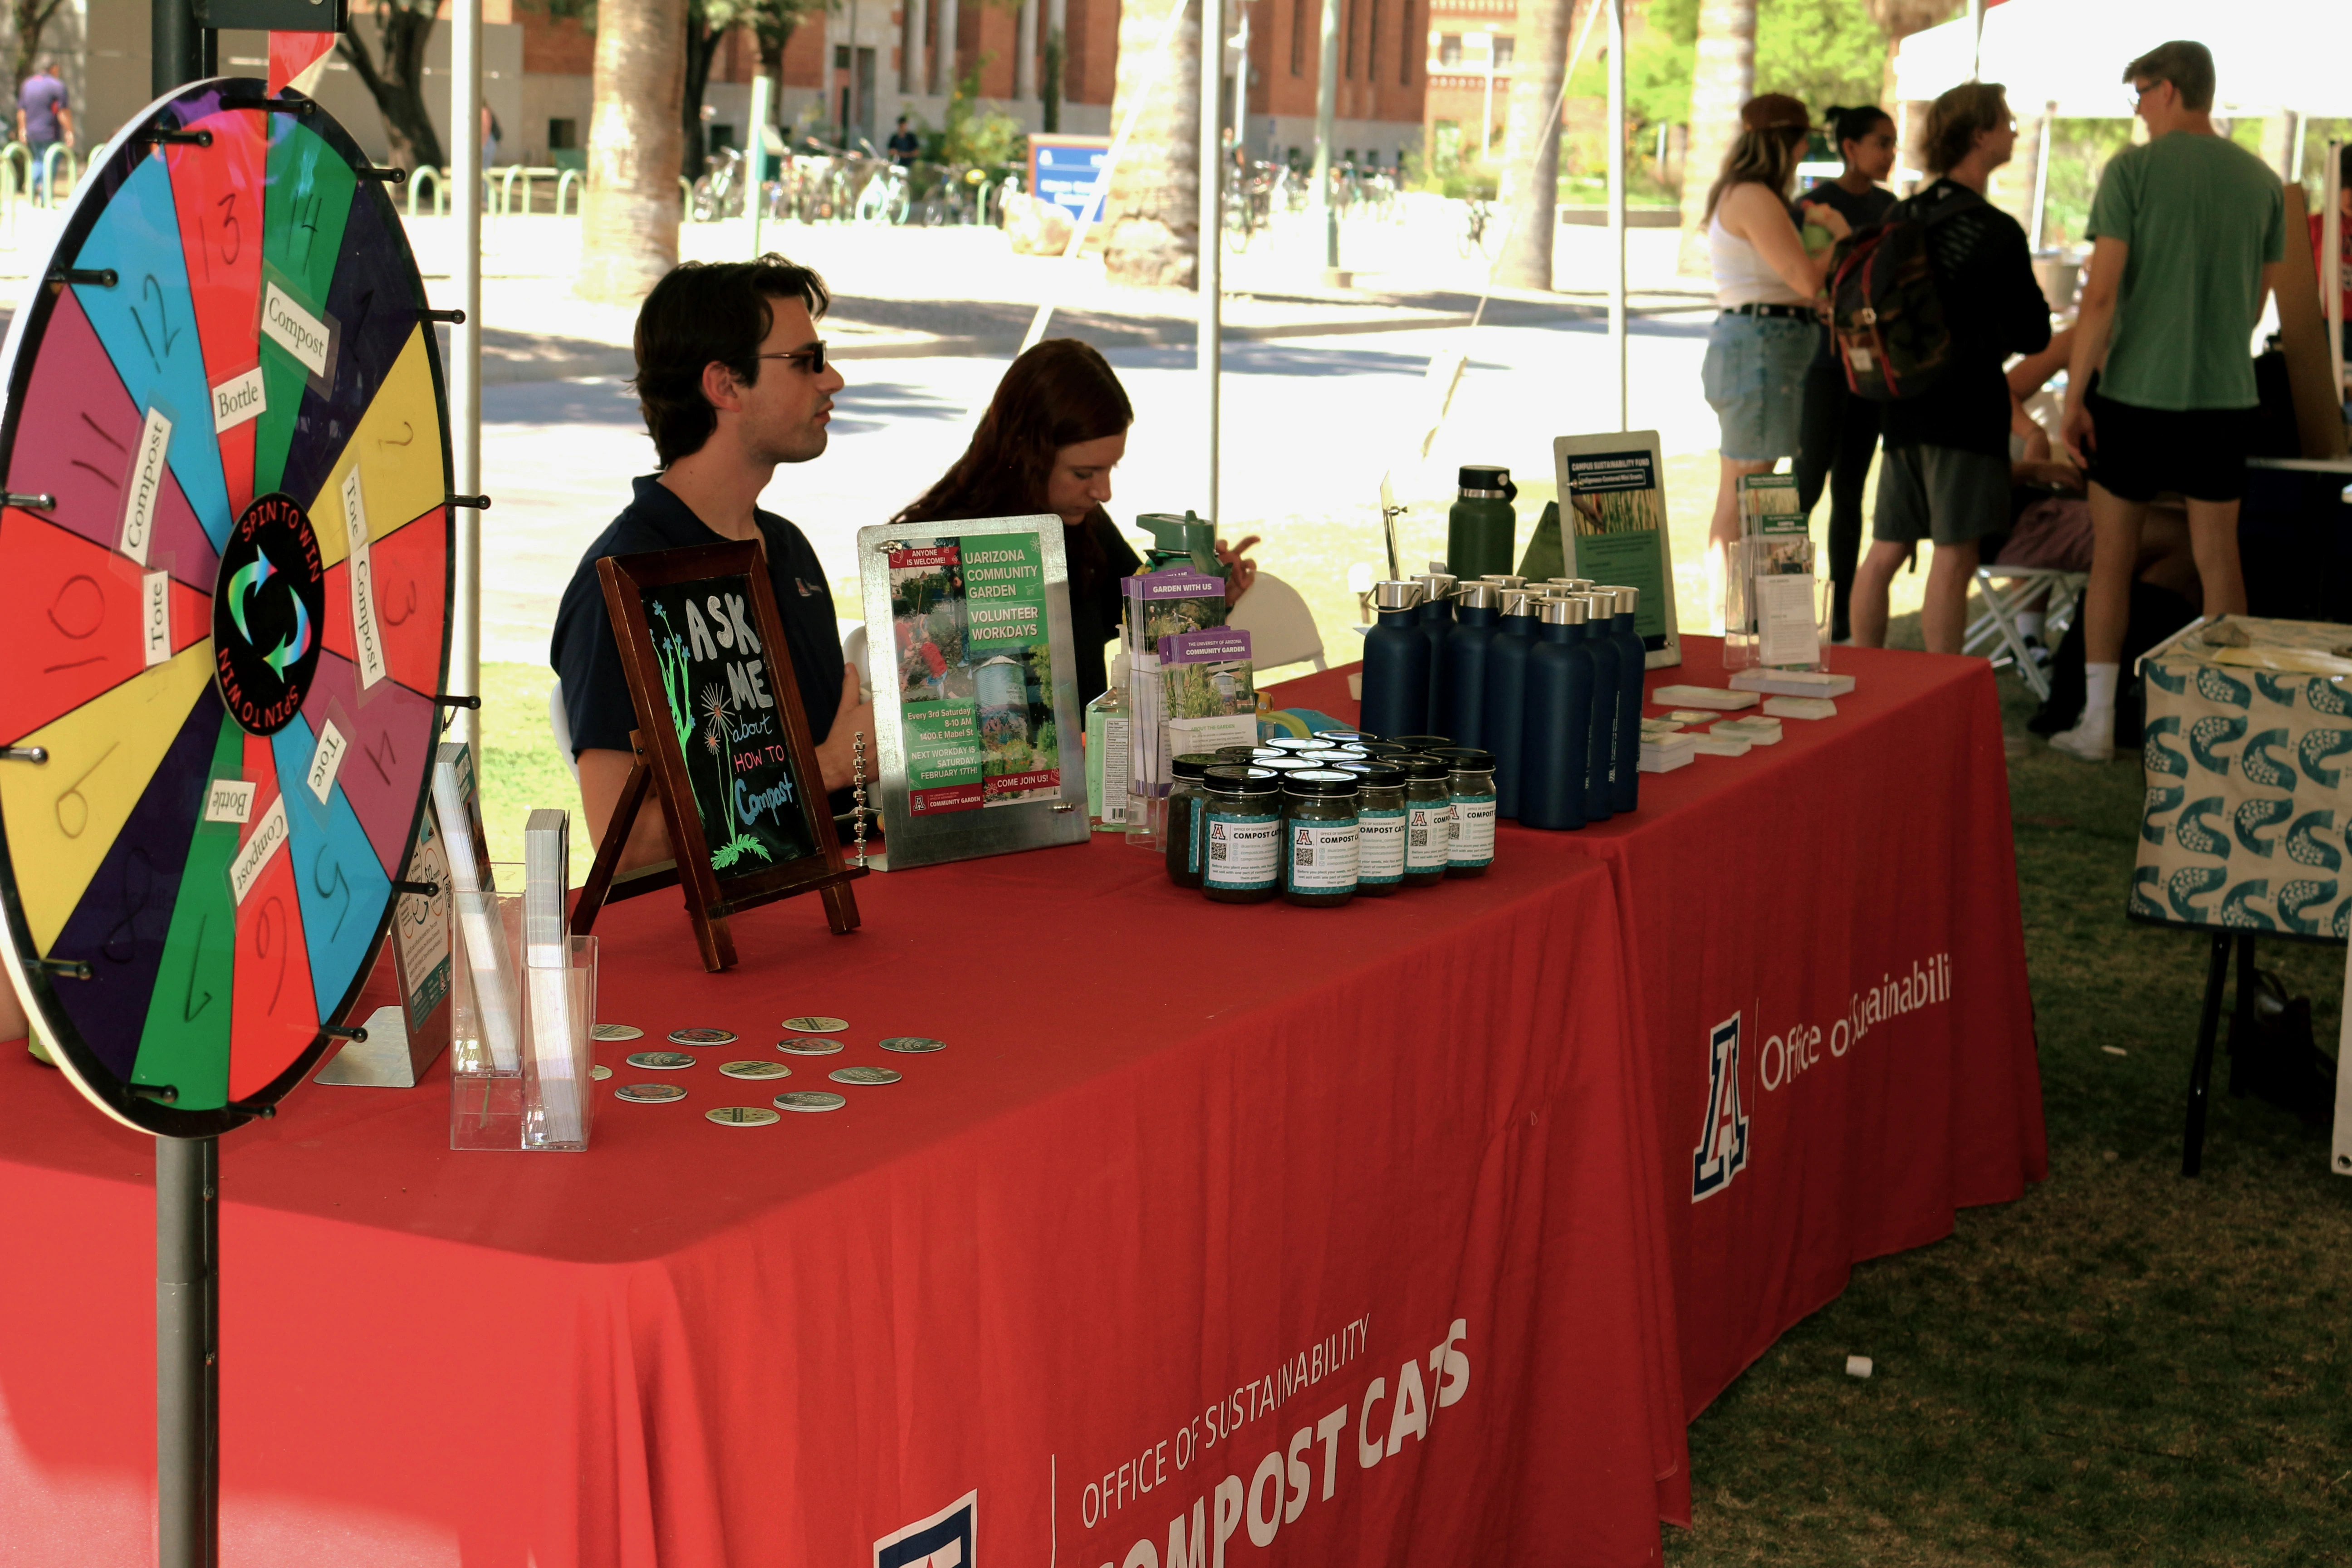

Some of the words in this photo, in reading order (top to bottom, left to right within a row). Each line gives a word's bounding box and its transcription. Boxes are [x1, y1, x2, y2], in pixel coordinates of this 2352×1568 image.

[199, 193, 241, 284] 13
[286, 189, 322, 277] 14
[130, 274, 181, 374] 12
[269, 297, 324, 358] Compost
[217, 381, 259, 418] Bottle
[1572, 462, 1593, 471] CAMPUS
[1594, 459, 1634, 470] SUSTAINABILITY
[1635, 458, 1650, 466] FUND
[128, 422, 164, 548] Compost
[346, 477, 359, 538] Tote
[242, 501, 277, 543] SPIN
[280, 501, 299, 529] TO
[299, 522, 321, 583] WIN
[911, 549, 938, 557] ANYONE
[912, 557, 946, 566] WELCOME!
[965, 549, 1026, 564] UARIZONA
[967, 565, 1038, 582] COMMUNITY
[383, 577, 417, 626] 3
[969, 584, 1017, 599] GARDEN
[1153, 585, 1182, 593] GARDEN
[44, 574, 108, 674] 10
[151, 582, 164, 650] Tote
[357, 560, 378, 674] Compost
[686, 592, 761, 662] ASK
[970, 606, 1039, 623] VOLUNTEER
[972, 623, 1038, 641] WORKDAYS
[1186, 647, 1221, 656] COMMUNITY
[218, 647, 242, 710] WIN
[726, 659, 774, 711] ME
[241, 701, 261, 728] TO
[265, 685, 299, 727] SPIN
[908, 711, 926, 721] Every
[928, 710, 940, 718] 3rd
[941, 708, 971, 717] Saturday
[732, 713, 773, 743] about
[920, 732, 936, 741] 1400
[944, 729, 965, 739] Mabel
[966, 728, 974, 736] St
[945, 719, 959, 727] 8-10
[314, 734, 340, 787] Tote
[734, 748, 763, 773] HOW
[765, 744, 785, 765] TO
[911, 751, 930, 760] NEXT
[932, 747, 967, 758] WORKDAY
[937, 757, 977, 768] SATURDAY,
[921, 769, 958, 780] FEBRUARY
[960, 767, 978, 776] 17TH!
[997, 778, 1019, 788] COME
[1020, 776, 1036, 785] JOIN
[1037, 774, 1049, 783] US!
[213, 791, 248, 816] Bottle
[734, 771, 793, 826] Compost
[930, 798, 960, 808] COMMUNITY
[1411, 811, 1427, 826] A
[1467, 810, 1494, 818] COMPOST
[1211, 824, 1225, 840] A
[1296, 829, 1312, 845] A
[1320, 835, 1354, 843] COMPOST
[238, 815, 284, 891] Compost
[1760, 1023, 1821, 1091] Office
[1691, 1009, 1749, 1205] A
[1081, 1439, 1167, 1529] OFFICE
[1176, 1415, 1200, 1470] OF
[1205, 1313, 1370, 1449] SUSTAINABILITY
[1096, 1404, 1348, 1568] MPOST
